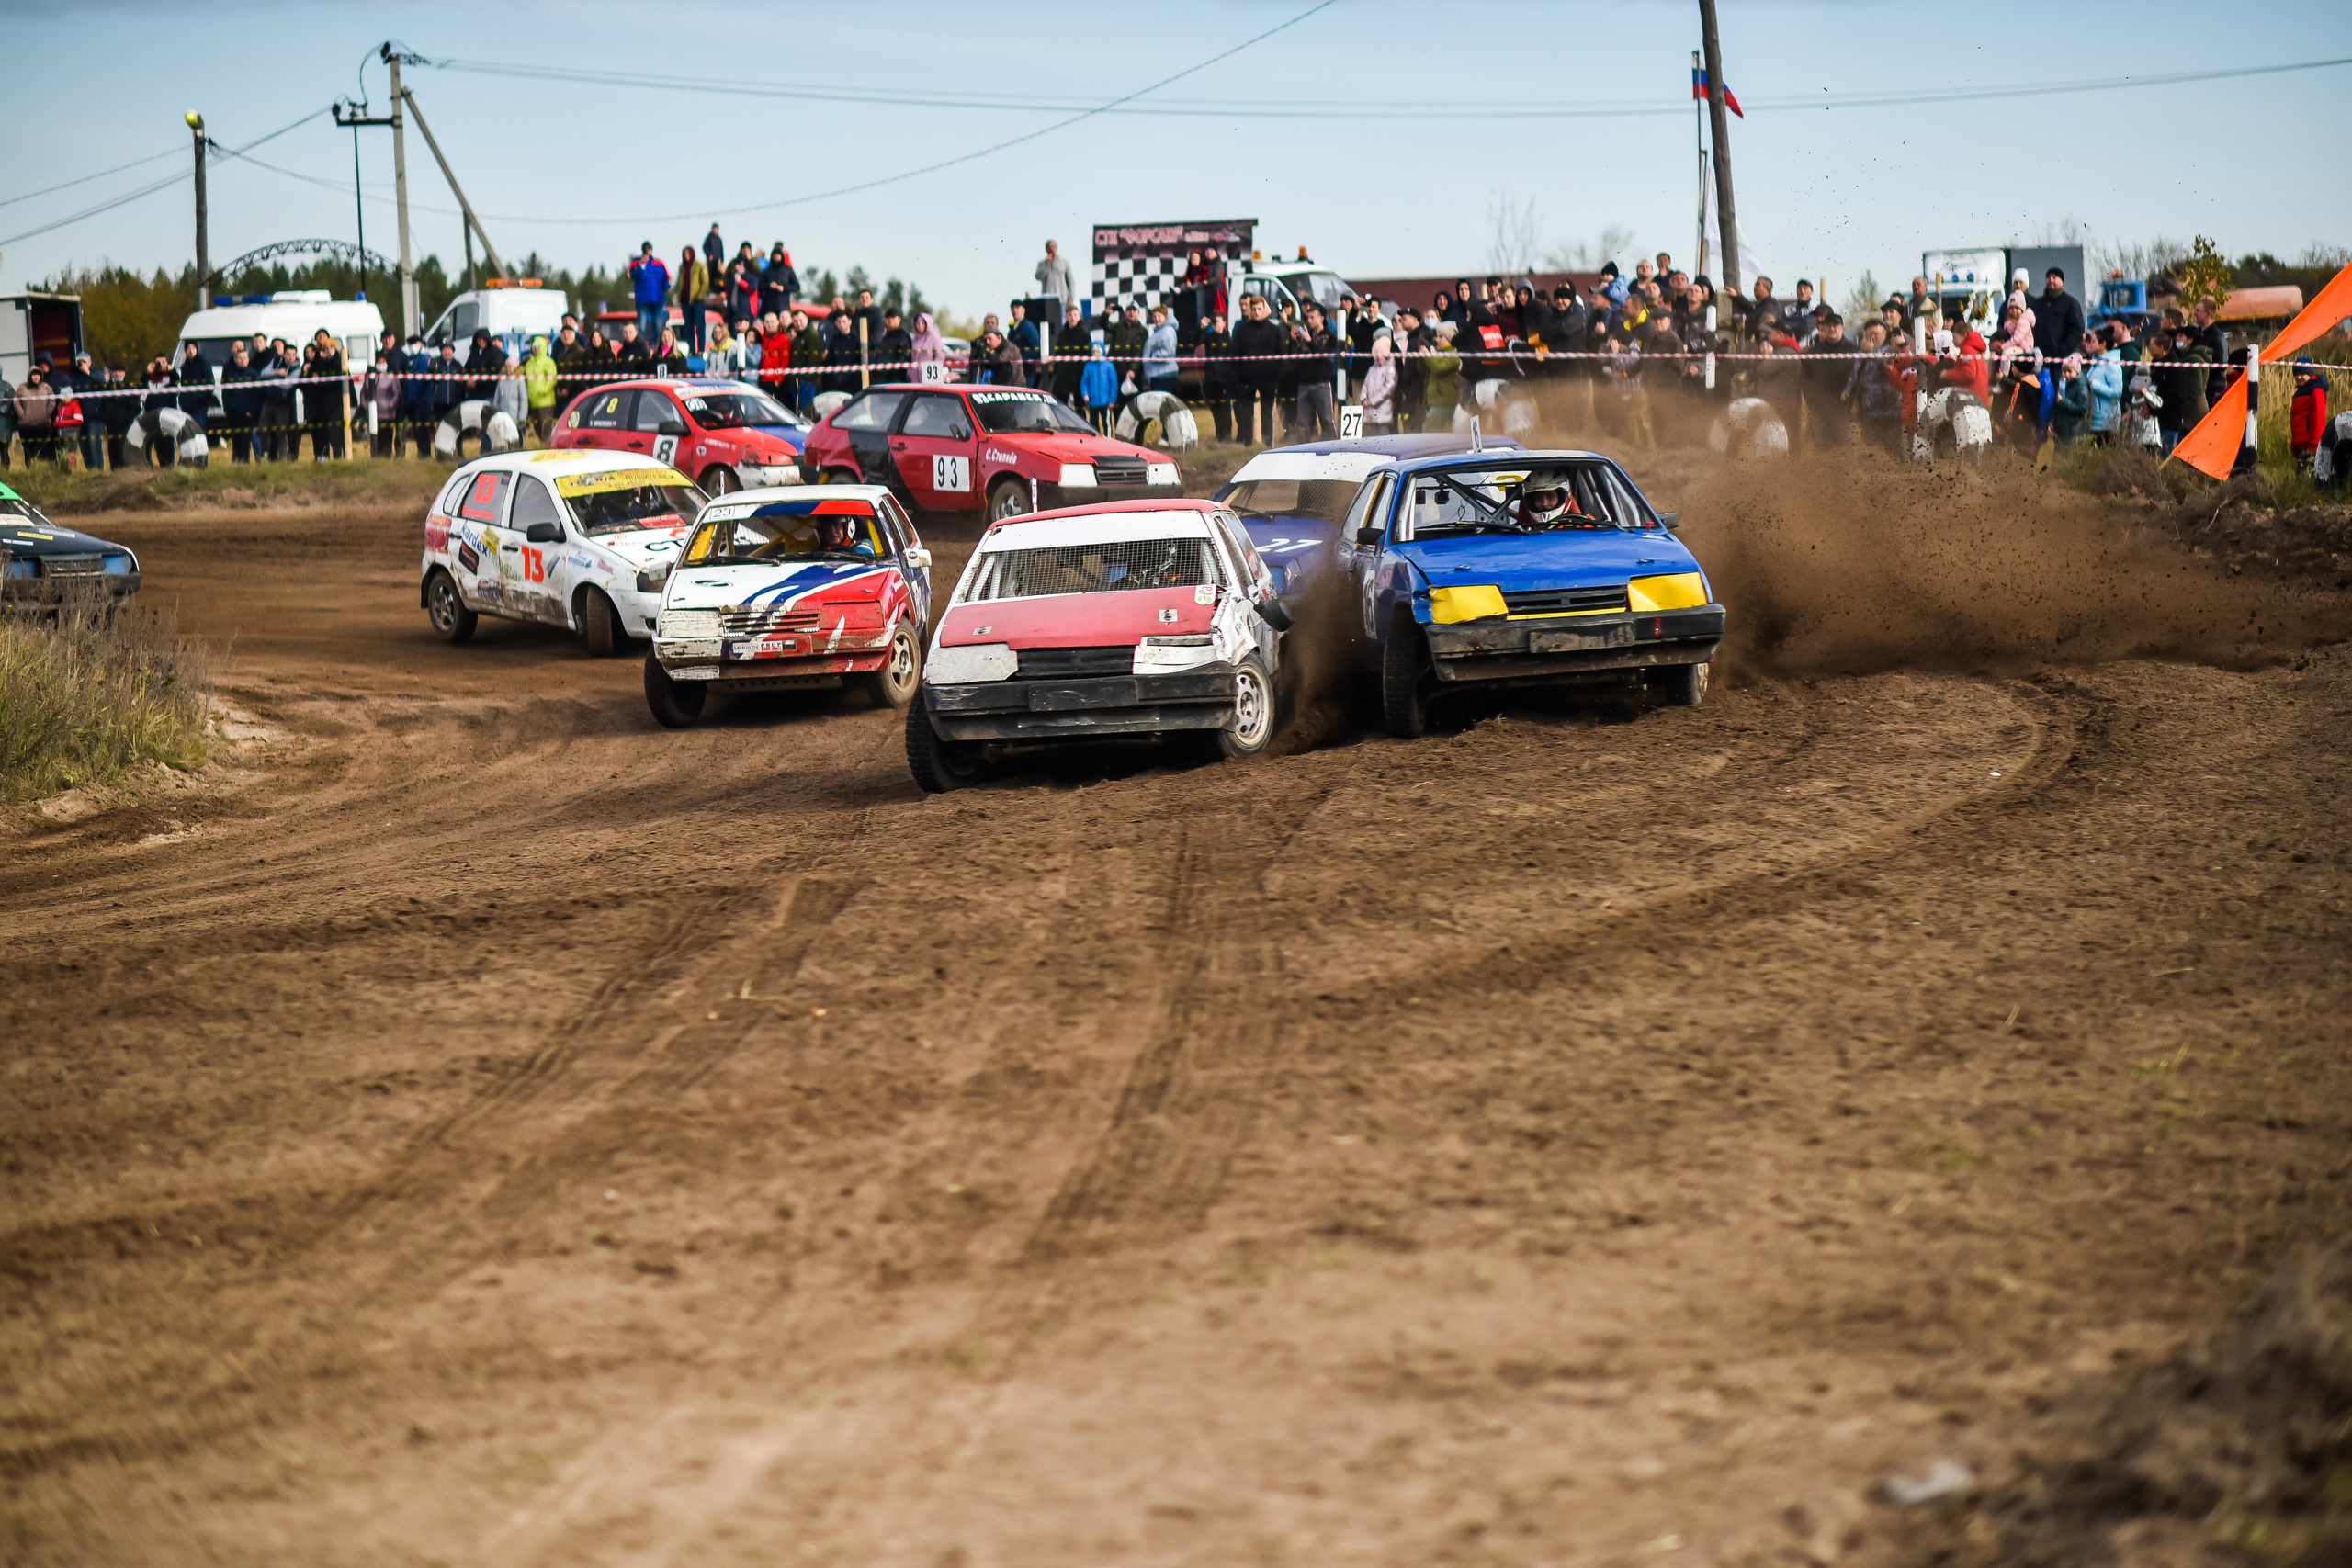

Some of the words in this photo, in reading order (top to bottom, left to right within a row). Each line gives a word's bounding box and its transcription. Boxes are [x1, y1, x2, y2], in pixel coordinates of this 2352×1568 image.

[1095, 230, 1118, 245] СТК
[927, 365, 938, 379] 93
[606, 397, 619, 414] 8
[1342, 413, 1362, 436] 27
[656, 439, 674, 463] 8
[937, 456, 958, 489] 93
[473, 473, 499, 504] 13
[713, 507, 731, 518] 23
[1255, 537, 1324, 553] 27
[521, 545, 545, 584] 13
